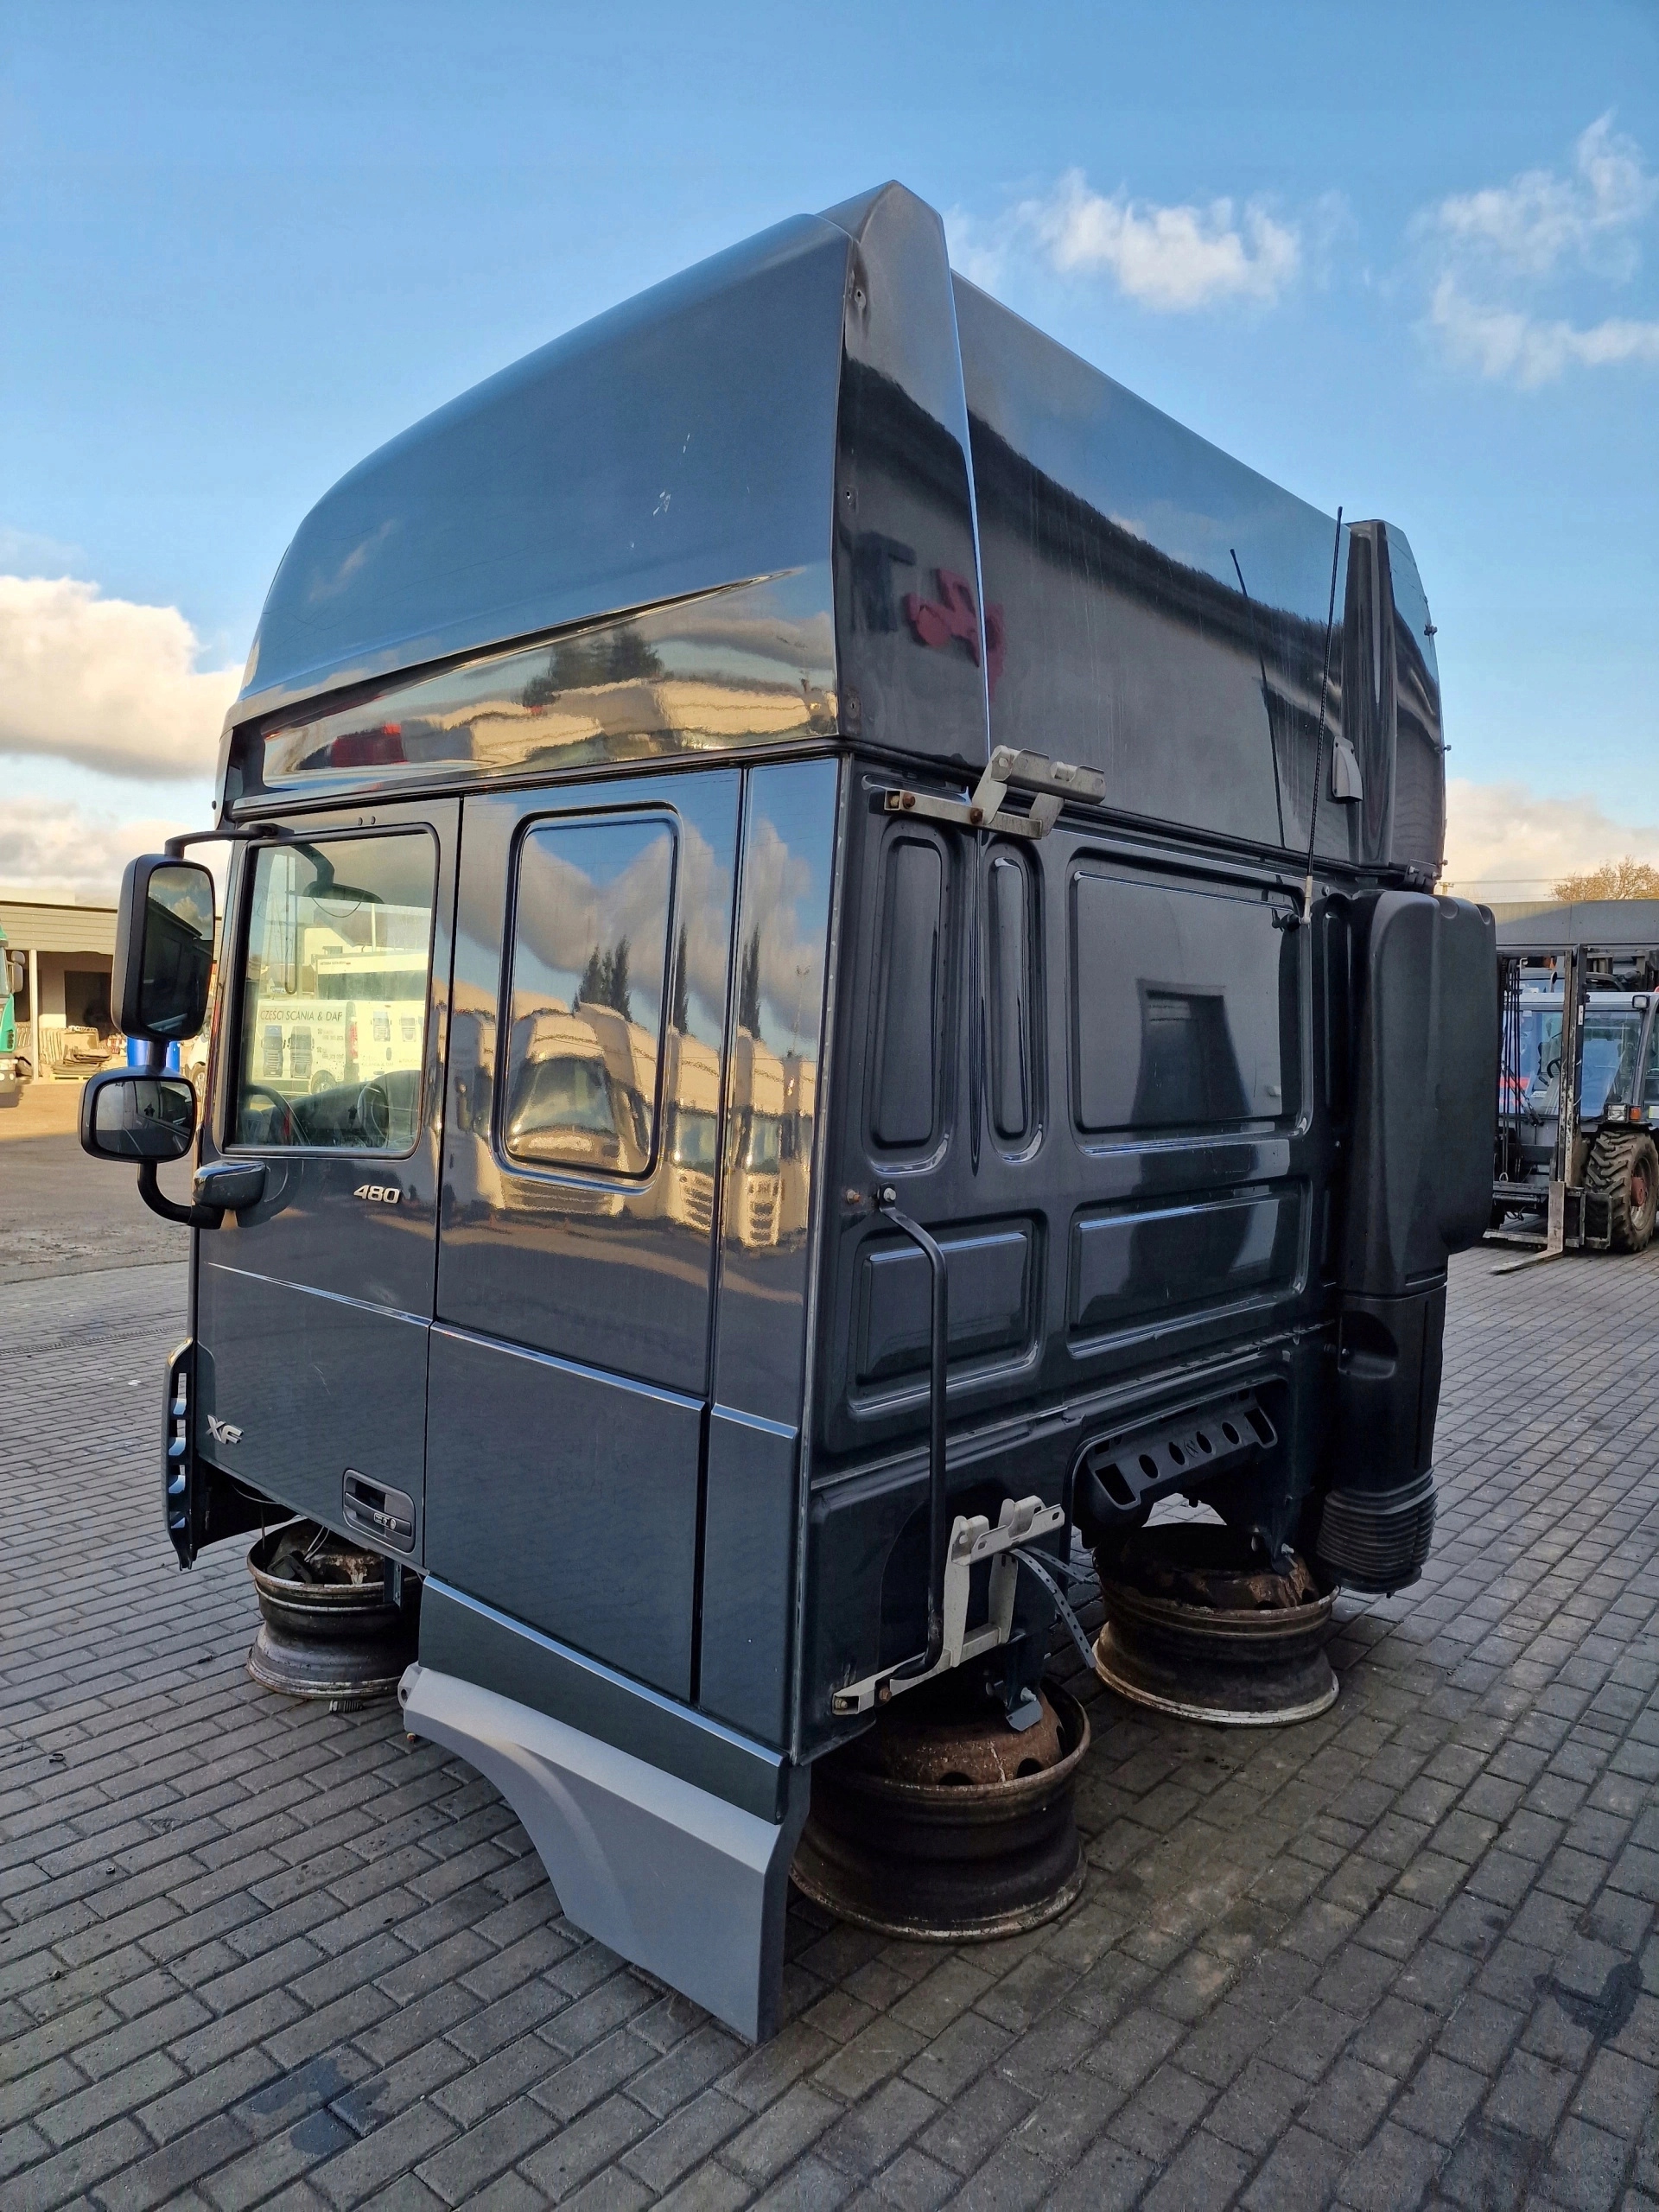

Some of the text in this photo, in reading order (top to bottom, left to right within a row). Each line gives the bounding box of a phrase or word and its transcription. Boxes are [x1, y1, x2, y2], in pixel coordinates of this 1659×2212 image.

[285, 1010, 315, 1021] SCANIA
[317, 1011, 323, 1021] &
[326, 1011, 342, 1021] DAF
[353, 1184, 400, 1204] 480
[206, 1414, 244, 1444] XF
